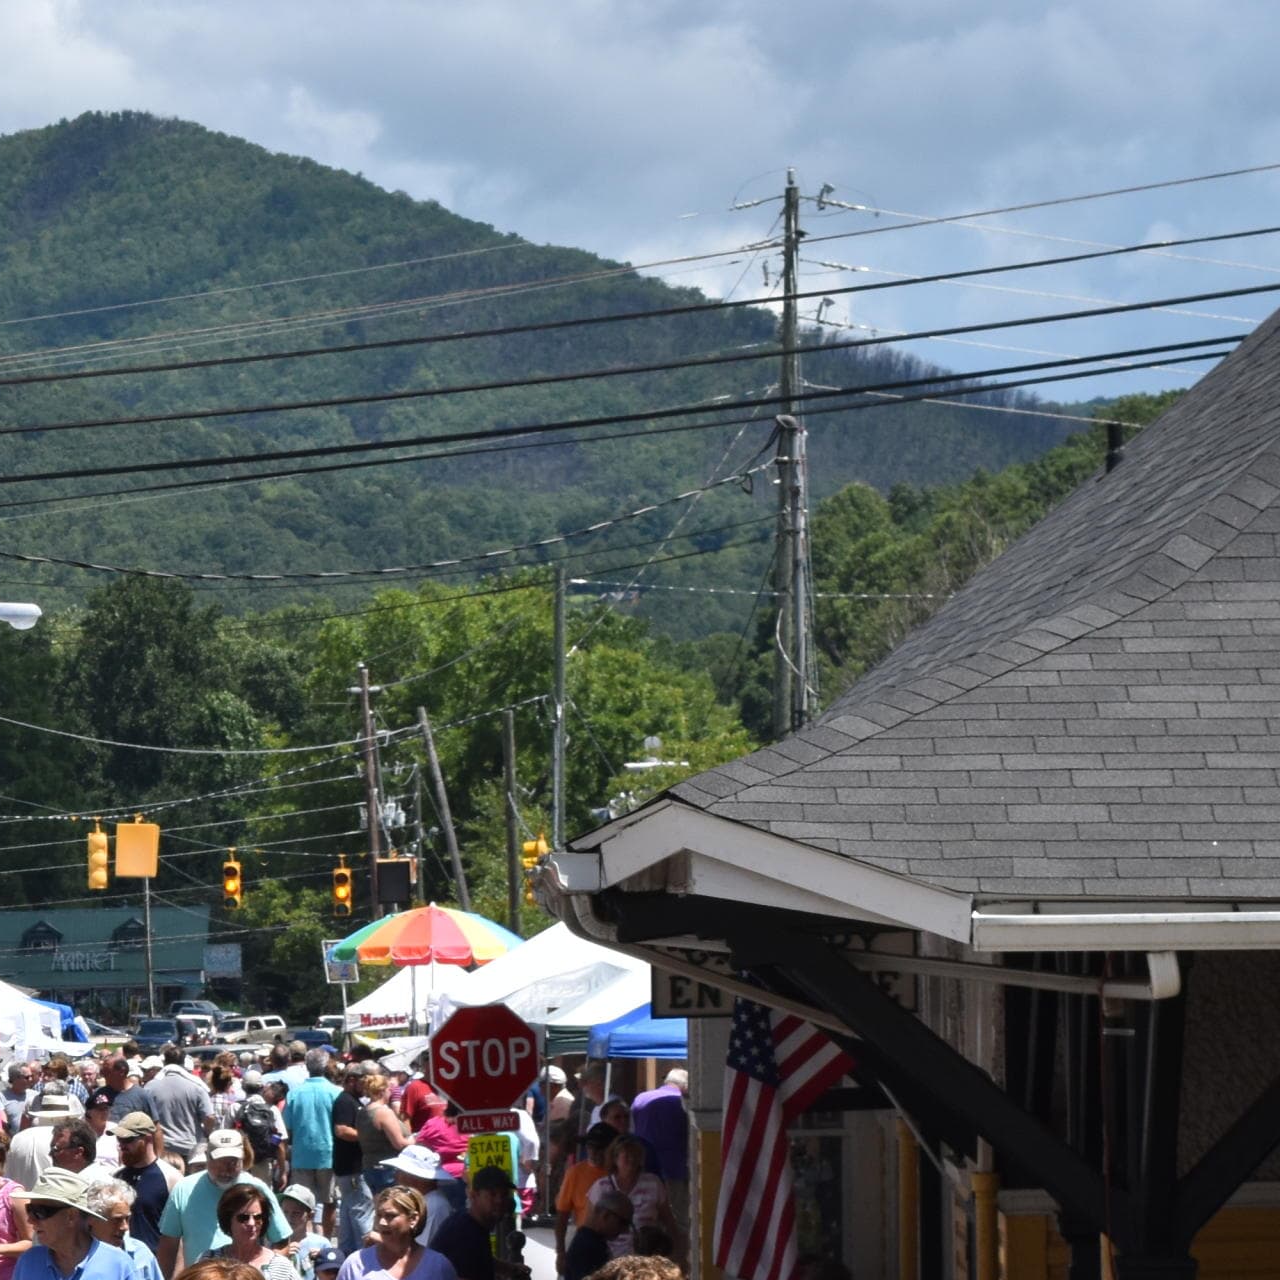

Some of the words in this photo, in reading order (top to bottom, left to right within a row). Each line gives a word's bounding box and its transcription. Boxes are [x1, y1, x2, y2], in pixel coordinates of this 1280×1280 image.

[51, 949, 120, 972] MARKET
[438, 1035, 533, 1081] STOP
[462, 1117, 485, 1131] ALL
[491, 1116, 515, 1129] WAY
[470, 1140, 510, 1155] STATE
[475, 1154, 505, 1168] LAW
